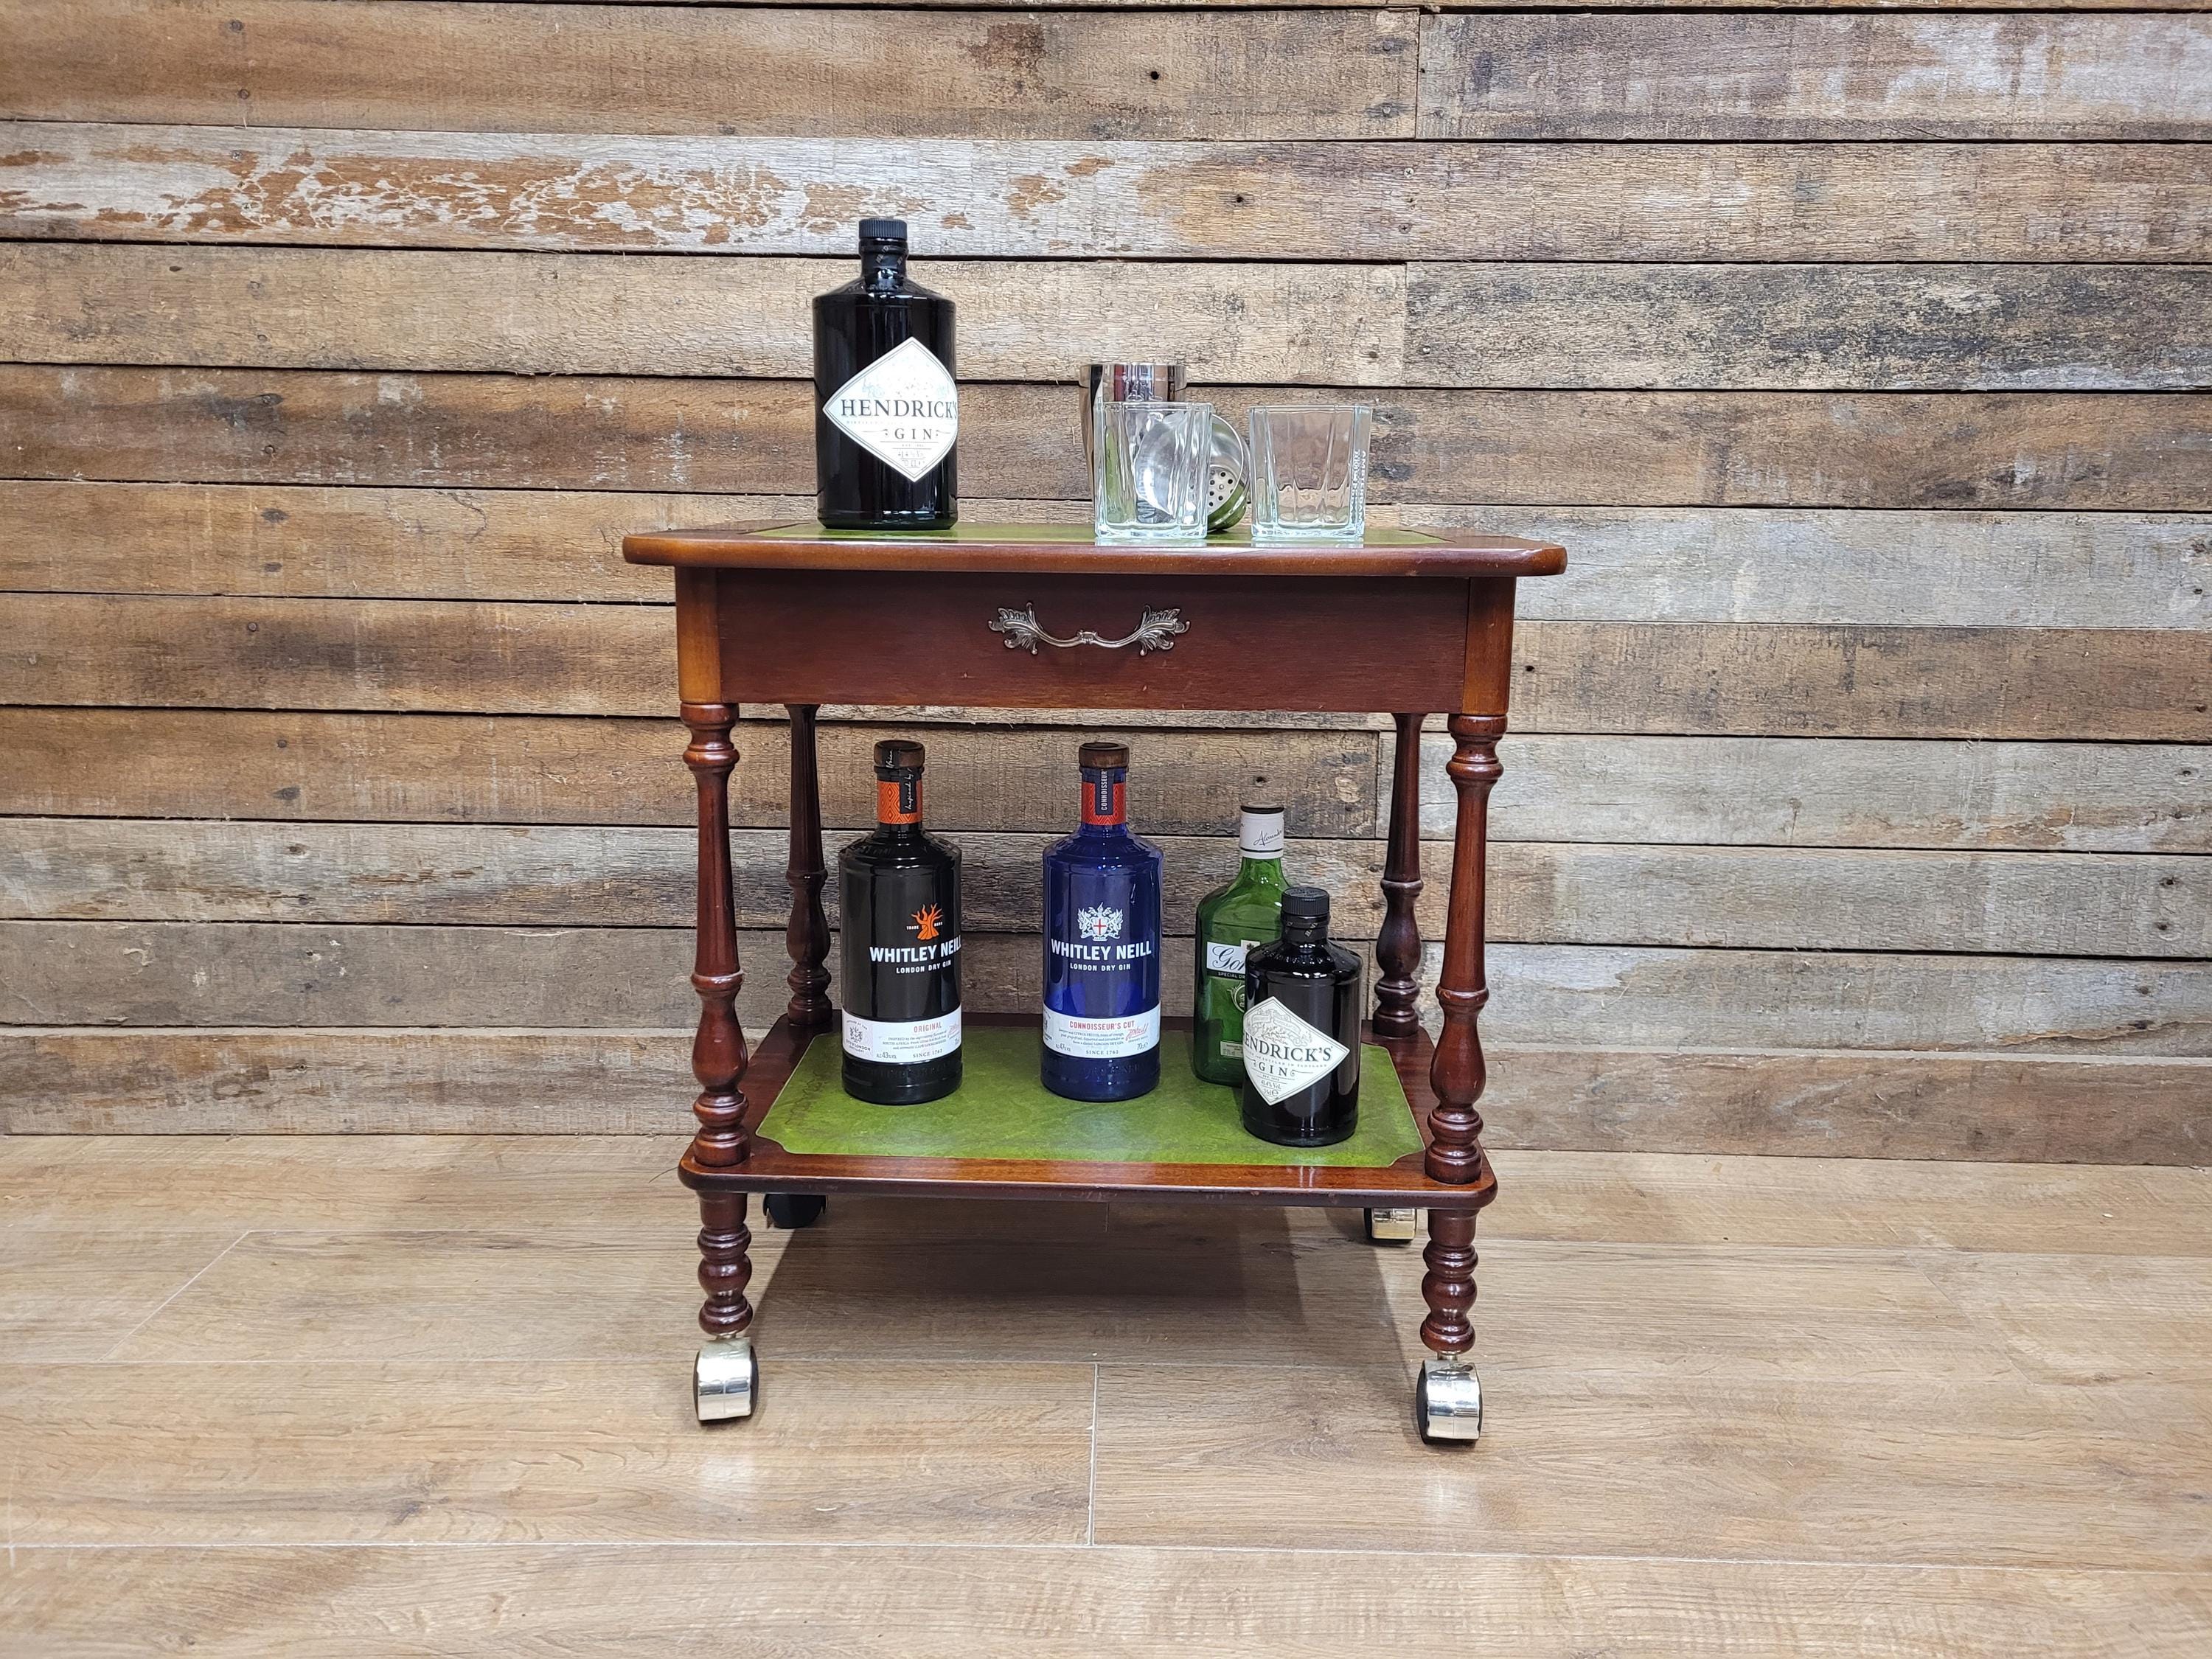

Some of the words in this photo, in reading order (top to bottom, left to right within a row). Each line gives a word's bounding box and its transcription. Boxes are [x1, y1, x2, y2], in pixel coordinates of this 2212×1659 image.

[894, 428, 933, 440] GIN
[869, 945, 937, 963] WHITLEY
[940, 934, 961, 958] NEILL
[1051, 938, 1111, 961] WHITLEY
[1116, 940, 1152, 960] NEILL
[896, 965, 925, 974] LONDON
[928, 962, 941, 971] DRY
[942, 959, 952, 967] GIN
[1070, 962, 1097, 971] LONDON
[914, 1021, 942, 1033] ORIGINAL
[1069, 1020, 1121, 1031] CONNOISSEUR'S
[1123, 1020, 1135, 1029] CUT
[1244, 1033, 1332, 1062] ENDRICK'S
[1258, 1061, 1288, 1077] GIN
